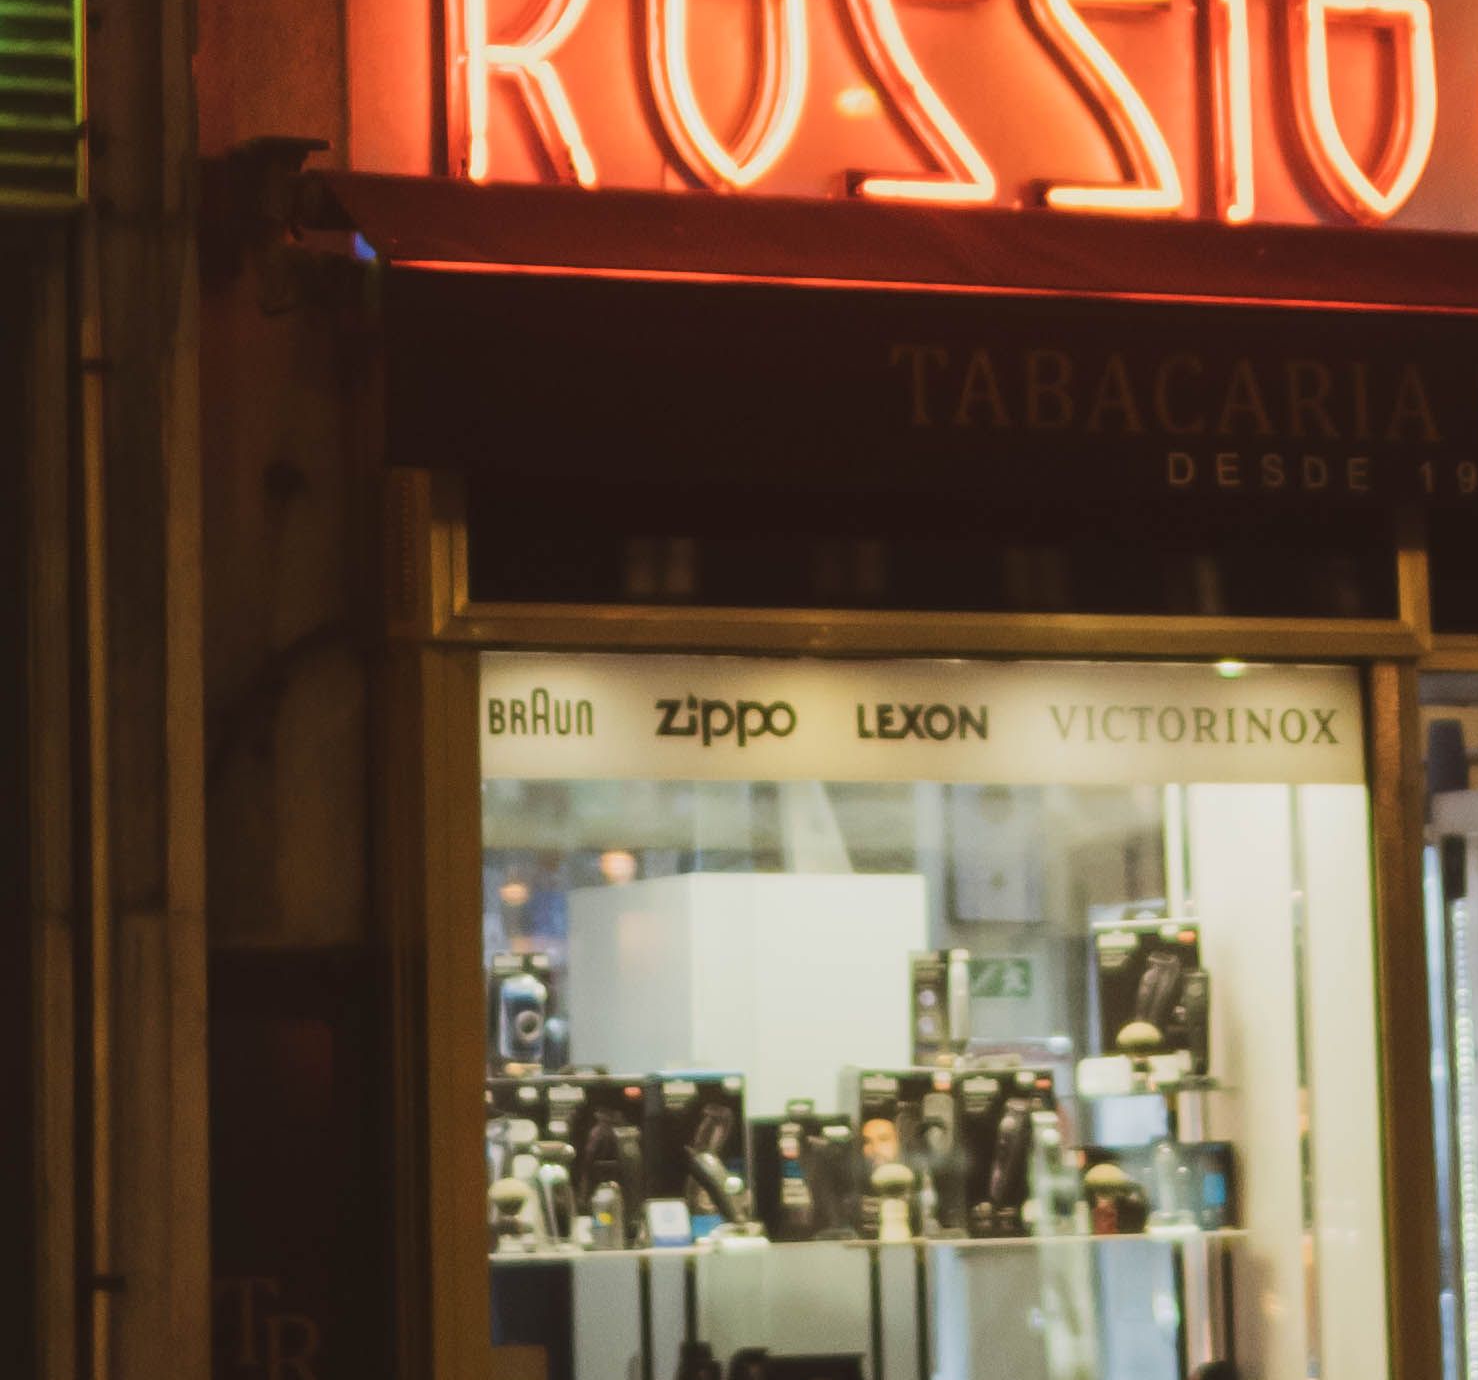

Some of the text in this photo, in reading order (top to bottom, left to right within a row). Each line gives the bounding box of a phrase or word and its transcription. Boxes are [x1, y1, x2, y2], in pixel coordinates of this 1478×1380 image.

[888, 343, 1444, 444] TABACARIA
[1167, 450, 1374, 493] DESDE
[856, 700, 989, 742] LEXON
[1049, 703, 1341, 746] VICTORINOX
